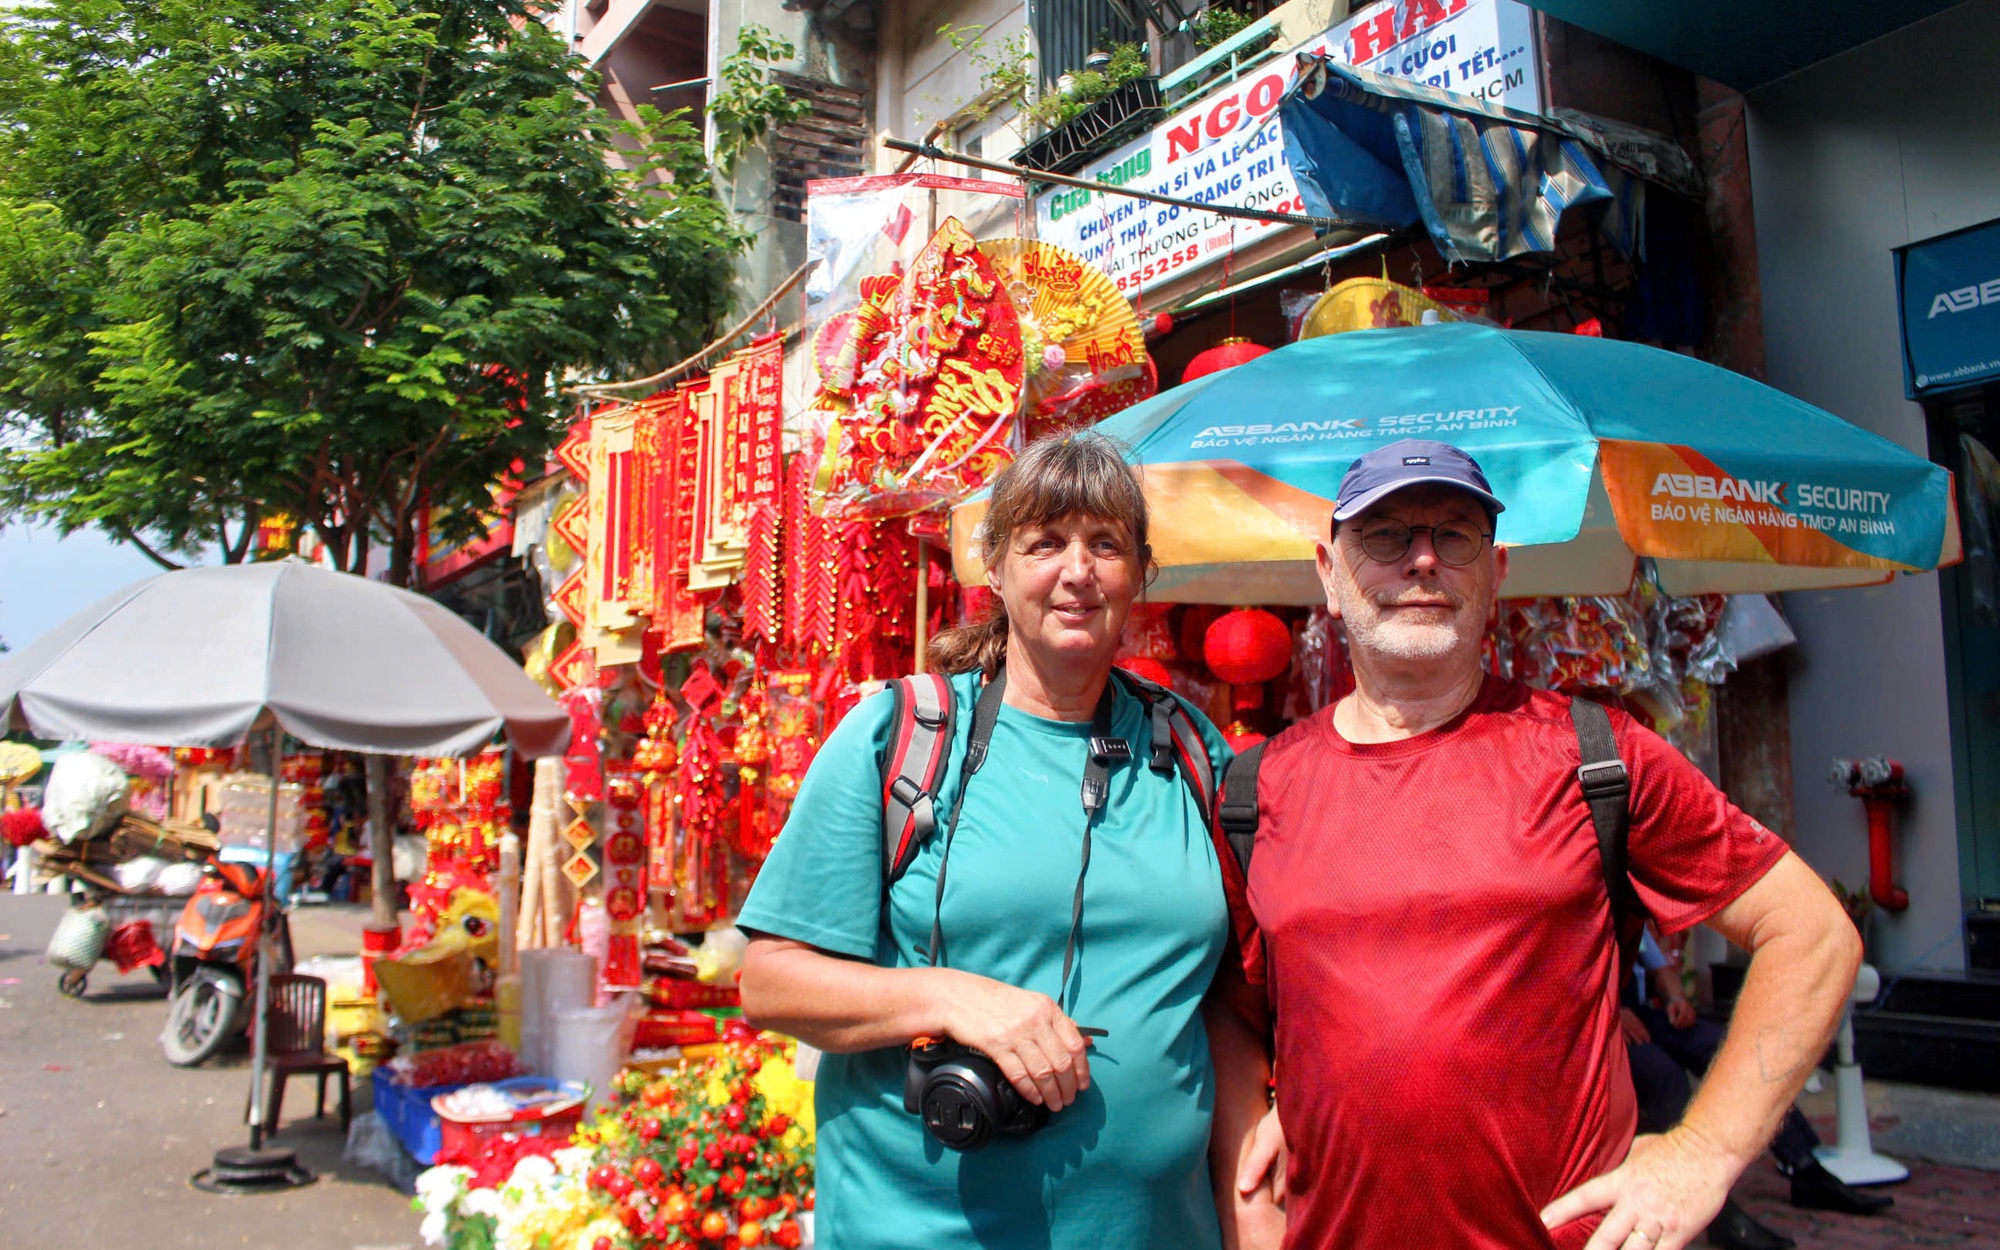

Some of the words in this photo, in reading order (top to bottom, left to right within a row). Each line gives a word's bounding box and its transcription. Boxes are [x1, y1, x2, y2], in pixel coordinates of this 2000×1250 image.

[1167, 62, 1299, 164] NGỌ
[1194, 418, 1359, 438] ABBANK
[1378, 406, 1522, 428] SECURITY
[1377, 425, 1432, 436] TMCP
[1434, 421, 1464, 433] AN
[1650, 473, 1781, 504] ABBANK
[1797, 483, 1891, 515] SECURITY
[1689, 503, 1711, 526] VỆ
[1715, 506, 1755, 525] NGÂN
[1758, 507, 1797, 528] HÀNG
[1800, 513, 1836, 531] TMCP
[1839, 517, 1857, 534] AN
[1860, 516, 1895, 536] BÌNH
